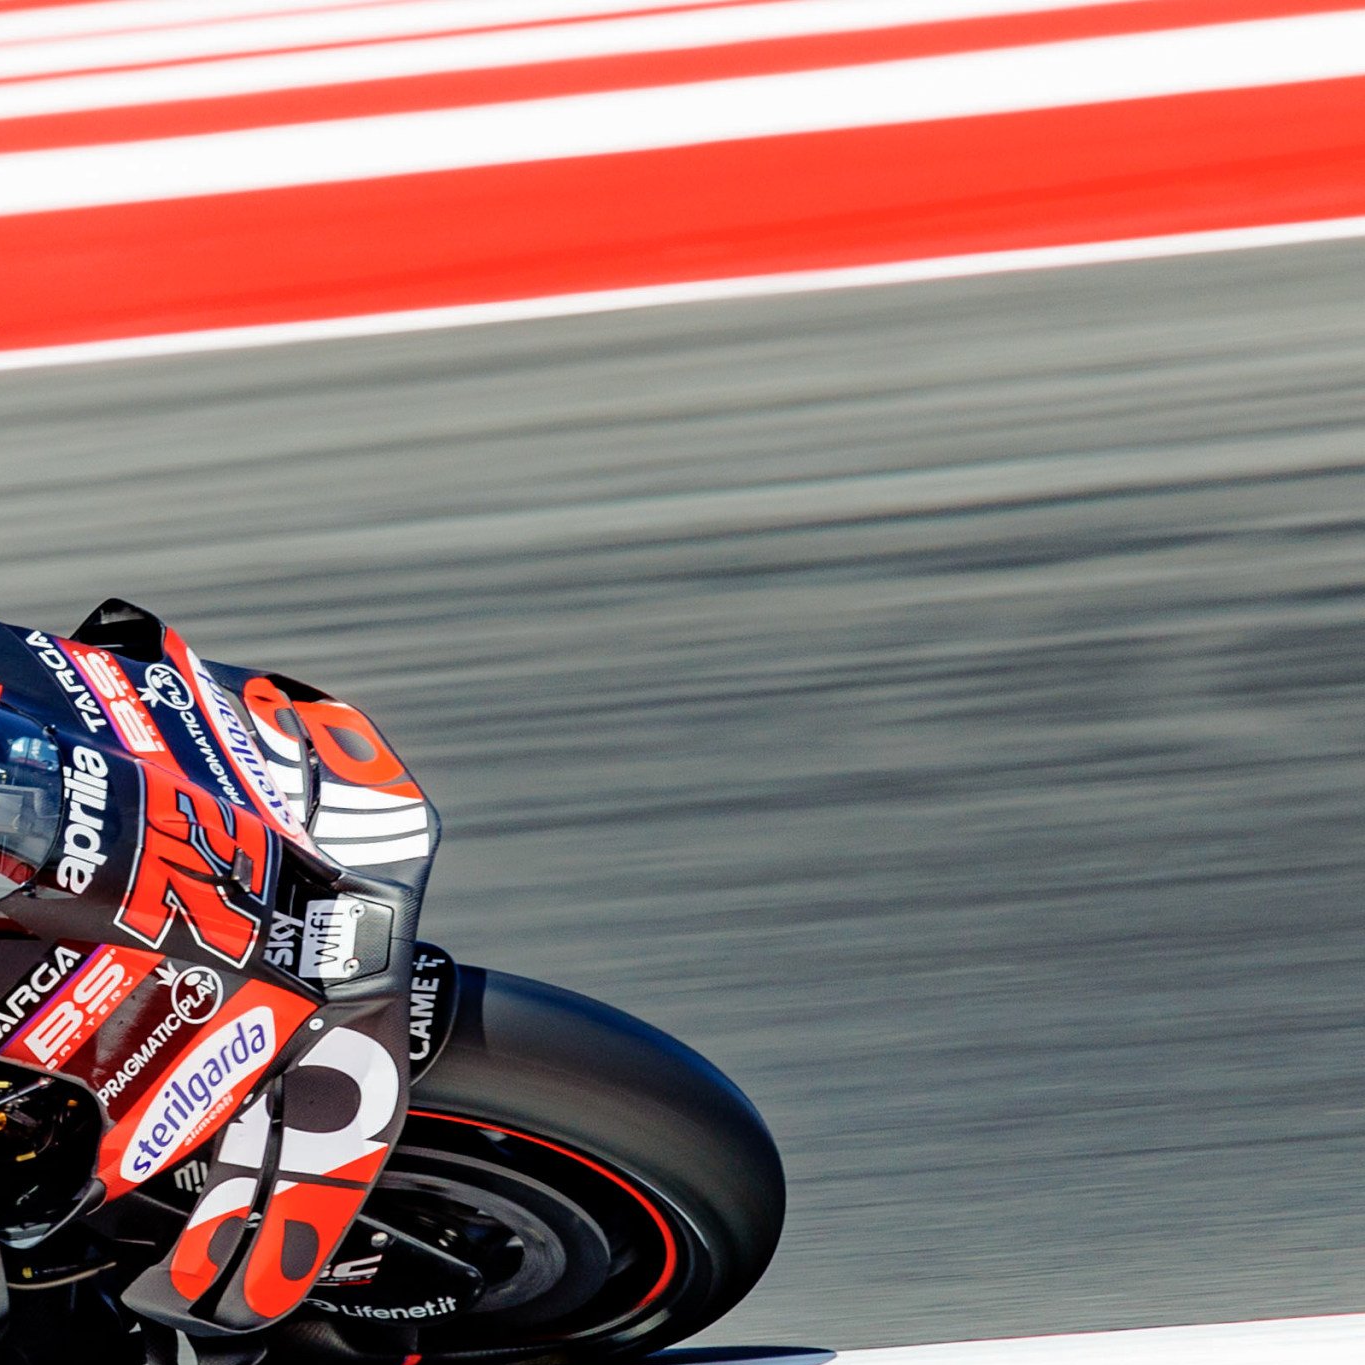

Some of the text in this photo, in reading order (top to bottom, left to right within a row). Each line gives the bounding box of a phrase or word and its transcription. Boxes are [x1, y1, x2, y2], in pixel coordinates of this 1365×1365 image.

[26, 631, 106, 733] TARGA
[153, 667, 246, 806] PRAGMATIC PLAY
[56, 745, 109, 895] aprilia
[310, 911, 345, 967] wifi
[97, 974, 216, 1107] PRAGMATIC PLAY
[409, 977, 440, 1061] CAME
[132, 1022, 267, 1175] sterilgarda
[184, 1092, 234, 1147] alimenti
[340, 1295, 458, 1320] Lifenet.it
